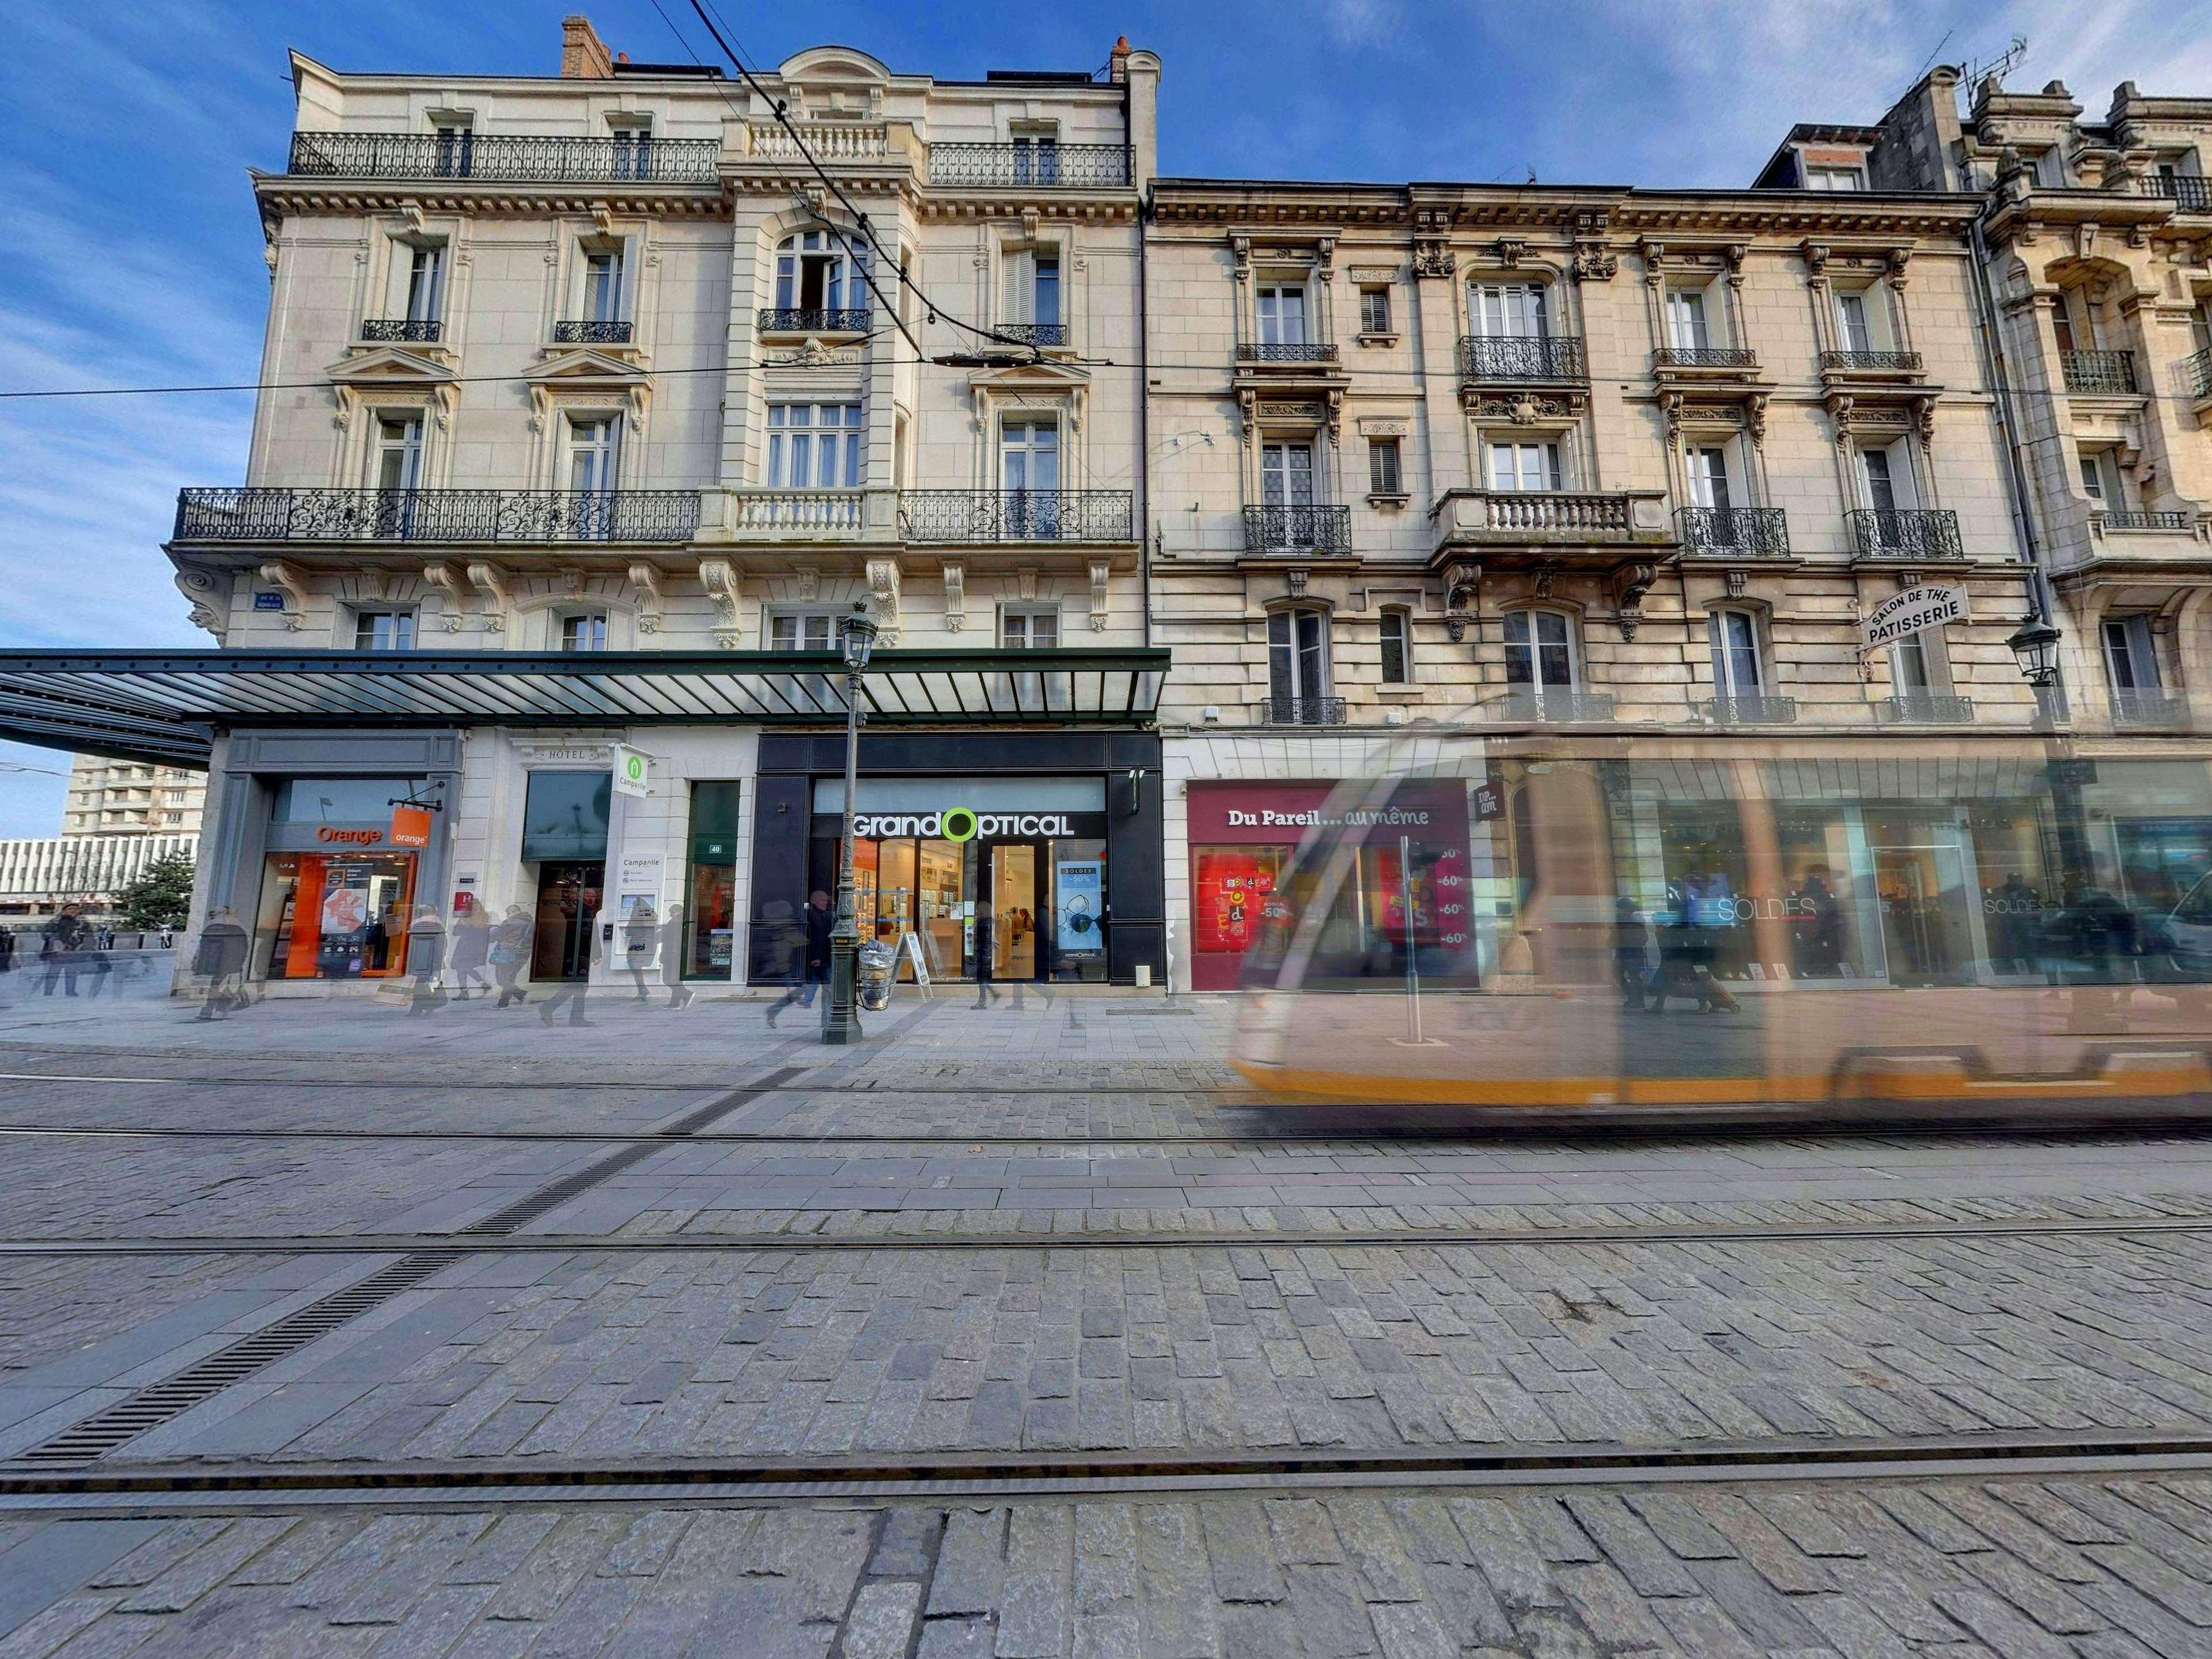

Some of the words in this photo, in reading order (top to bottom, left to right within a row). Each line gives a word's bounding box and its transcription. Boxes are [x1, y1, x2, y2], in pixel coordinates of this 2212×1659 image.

[1872, 597, 1905, 626] SALON
[1908, 590, 1922, 603] DE
[1927, 589, 1950, 602] THE
[1869, 600, 1959, 642] PATISSERIE
[619, 777, 646, 791] Campanile
[1481, 800, 1497, 814] am
[1228, 810, 1257, 826] Du
[1345, 813, 1367, 826] au
[1371, 808, 1429, 826] même
[316, 826, 383, 846] Orange
[396, 834, 425, 844] orange
[623, 859, 659, 867] Campanile
[1438, 876, 1463, 886] -60%
[1439, 904, 1465, 915] -60%
[1718, 897, 1817, 921] SOLDES
[1983, 899, 2046, 914] SOLDES
[1441, 933, 1468, 944] -60%
